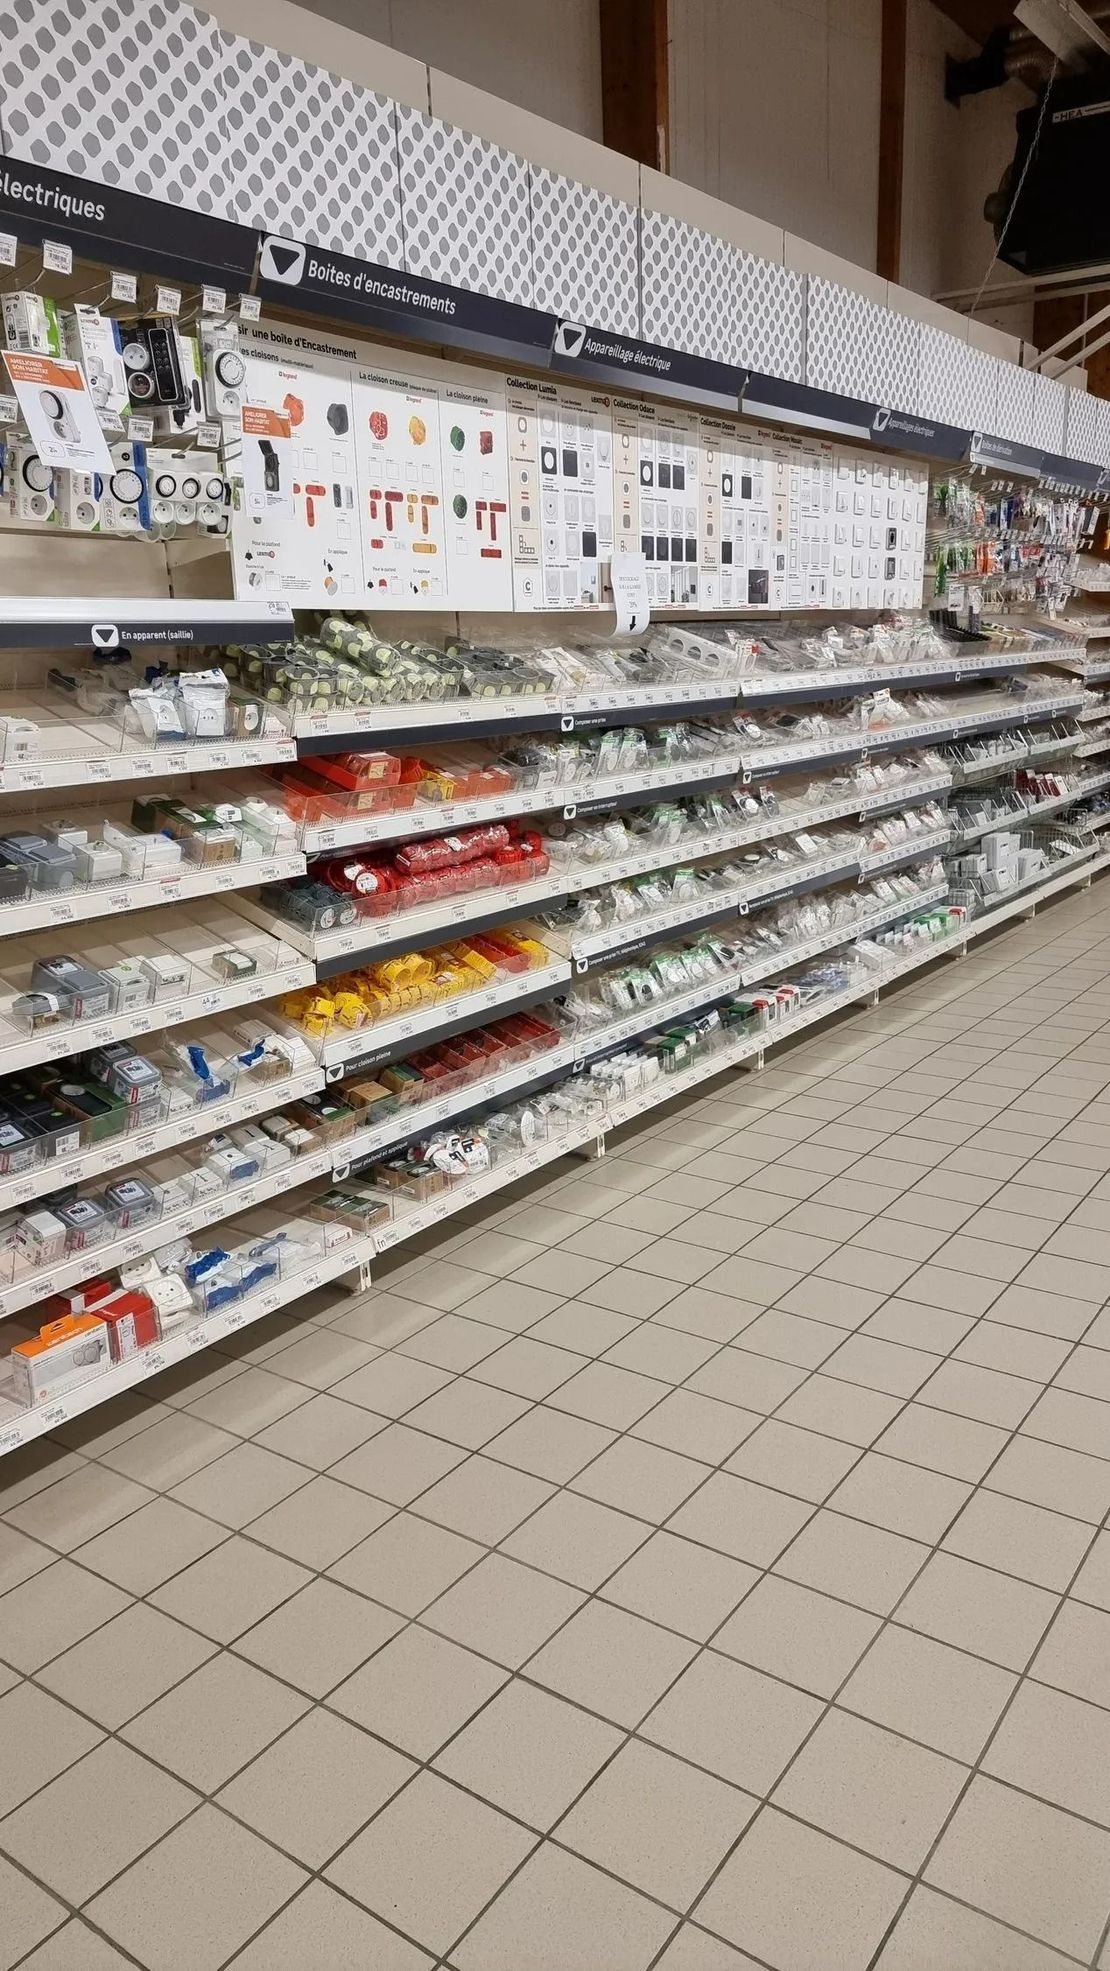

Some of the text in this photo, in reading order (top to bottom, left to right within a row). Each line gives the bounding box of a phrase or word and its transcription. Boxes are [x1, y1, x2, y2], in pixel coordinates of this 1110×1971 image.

[0, 170, 105, 221] lectriques
[308, 259, 456, 315] Boites d'encastrements
[252, 329, 269, 340] une
[294, 337, 357, 360] d'Encastrement
[251, 349, 279, 362] cloisons
[584, 338, 671, 372] Appareillage électrique
[359, 371, 366, 380] La
[368, 373, 388, 385] cloison
[389, 379, 408, 388] creuse
[506, 377, 557, 395] Collection Lumia
[446, 390, 488, 404] La cloison pleine
[613, 399, 655, 415] Collection Odace
[700, 418, 721, 428] Collection
[121, 629, 194, 640] En apparent (saillie)
[345, 1051, 391, 1072] Pour cloison pleine
[351, 1162, 363, 1171] Pour
